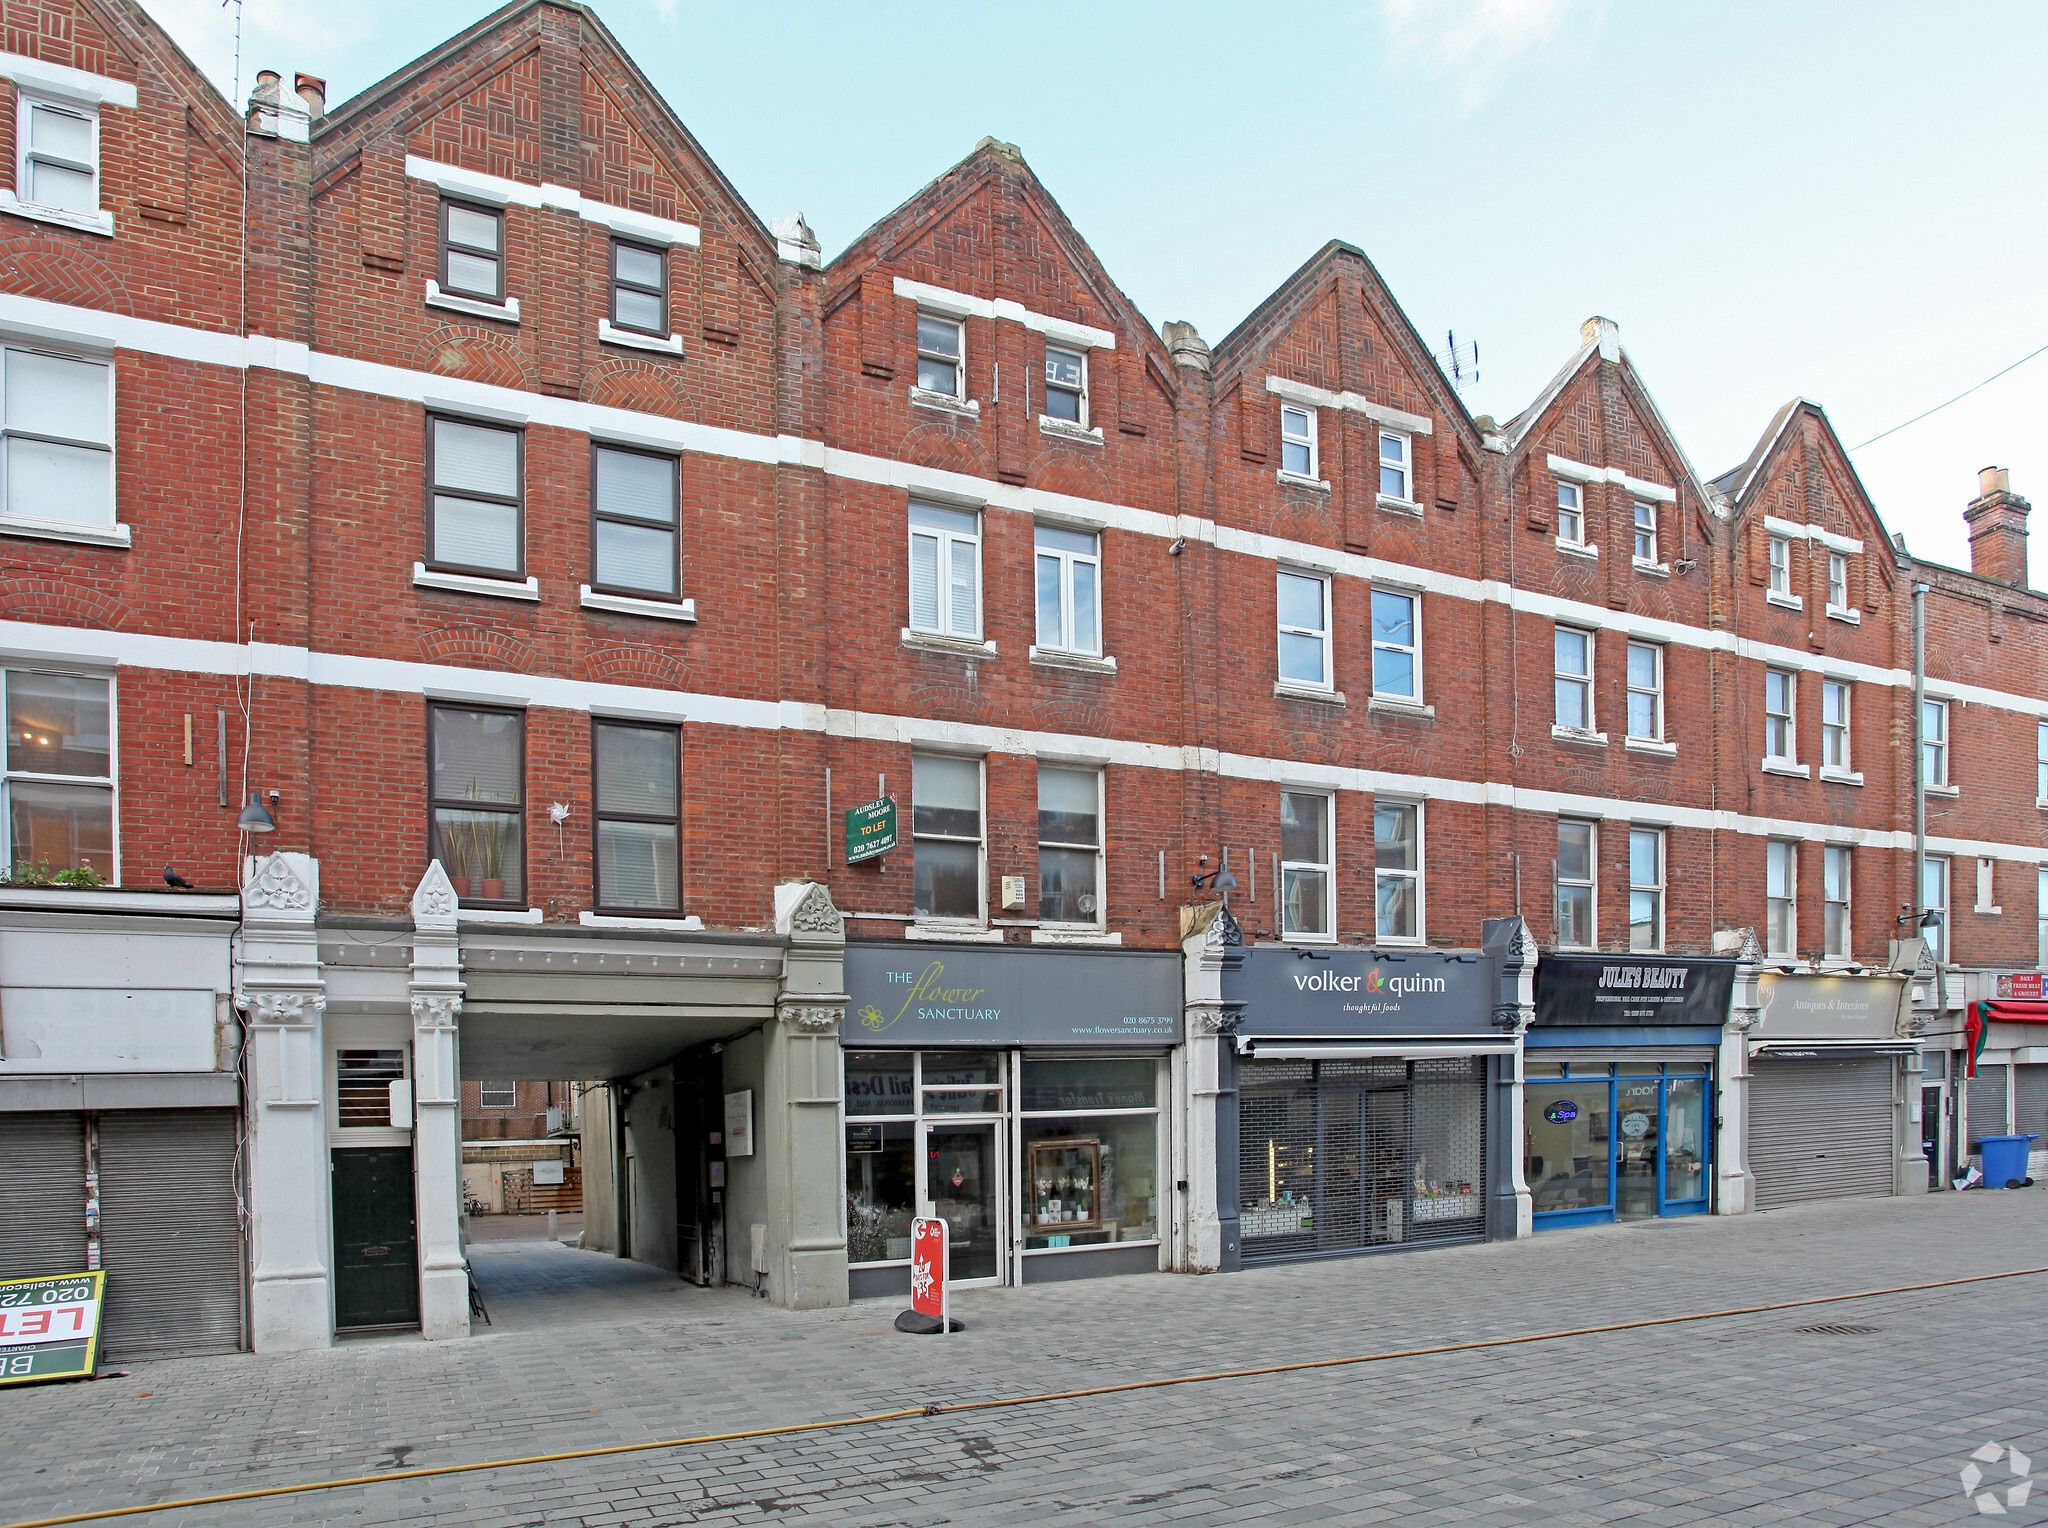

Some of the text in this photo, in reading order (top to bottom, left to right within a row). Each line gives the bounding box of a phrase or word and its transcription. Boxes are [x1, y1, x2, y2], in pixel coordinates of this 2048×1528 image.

[854, 799, 885, 815] AUDSLEY
[867, 805, 891, 819] MOORE
[861, 820, 887, 836] TO LET
[853, 844, 865, 854] 020
[865, 839, 880, 850] 7627
[886, 971, 913, 984] THE
[1293, 967, 1446, 998] volker & quinn
[1598, 966, 1688, 989] JULIE'S BEAUTY
[896, 960, 985, 1018] flower
[1343, 1003, 1401, 1014] thoughtful foods
[1793, 999, 1869, 1013] Antiques & Interiors
[918, 1008, 1001, 1020] SANCTUARY
[1123, 1016, 1174, 1026] 020 8675 3799
[1071, 1025, 1174, 1035] www.flowersanctuary.co.uk
[1557, 1110, 1576, 1120] Spa
[42, 1286, 89, 1303] 020
